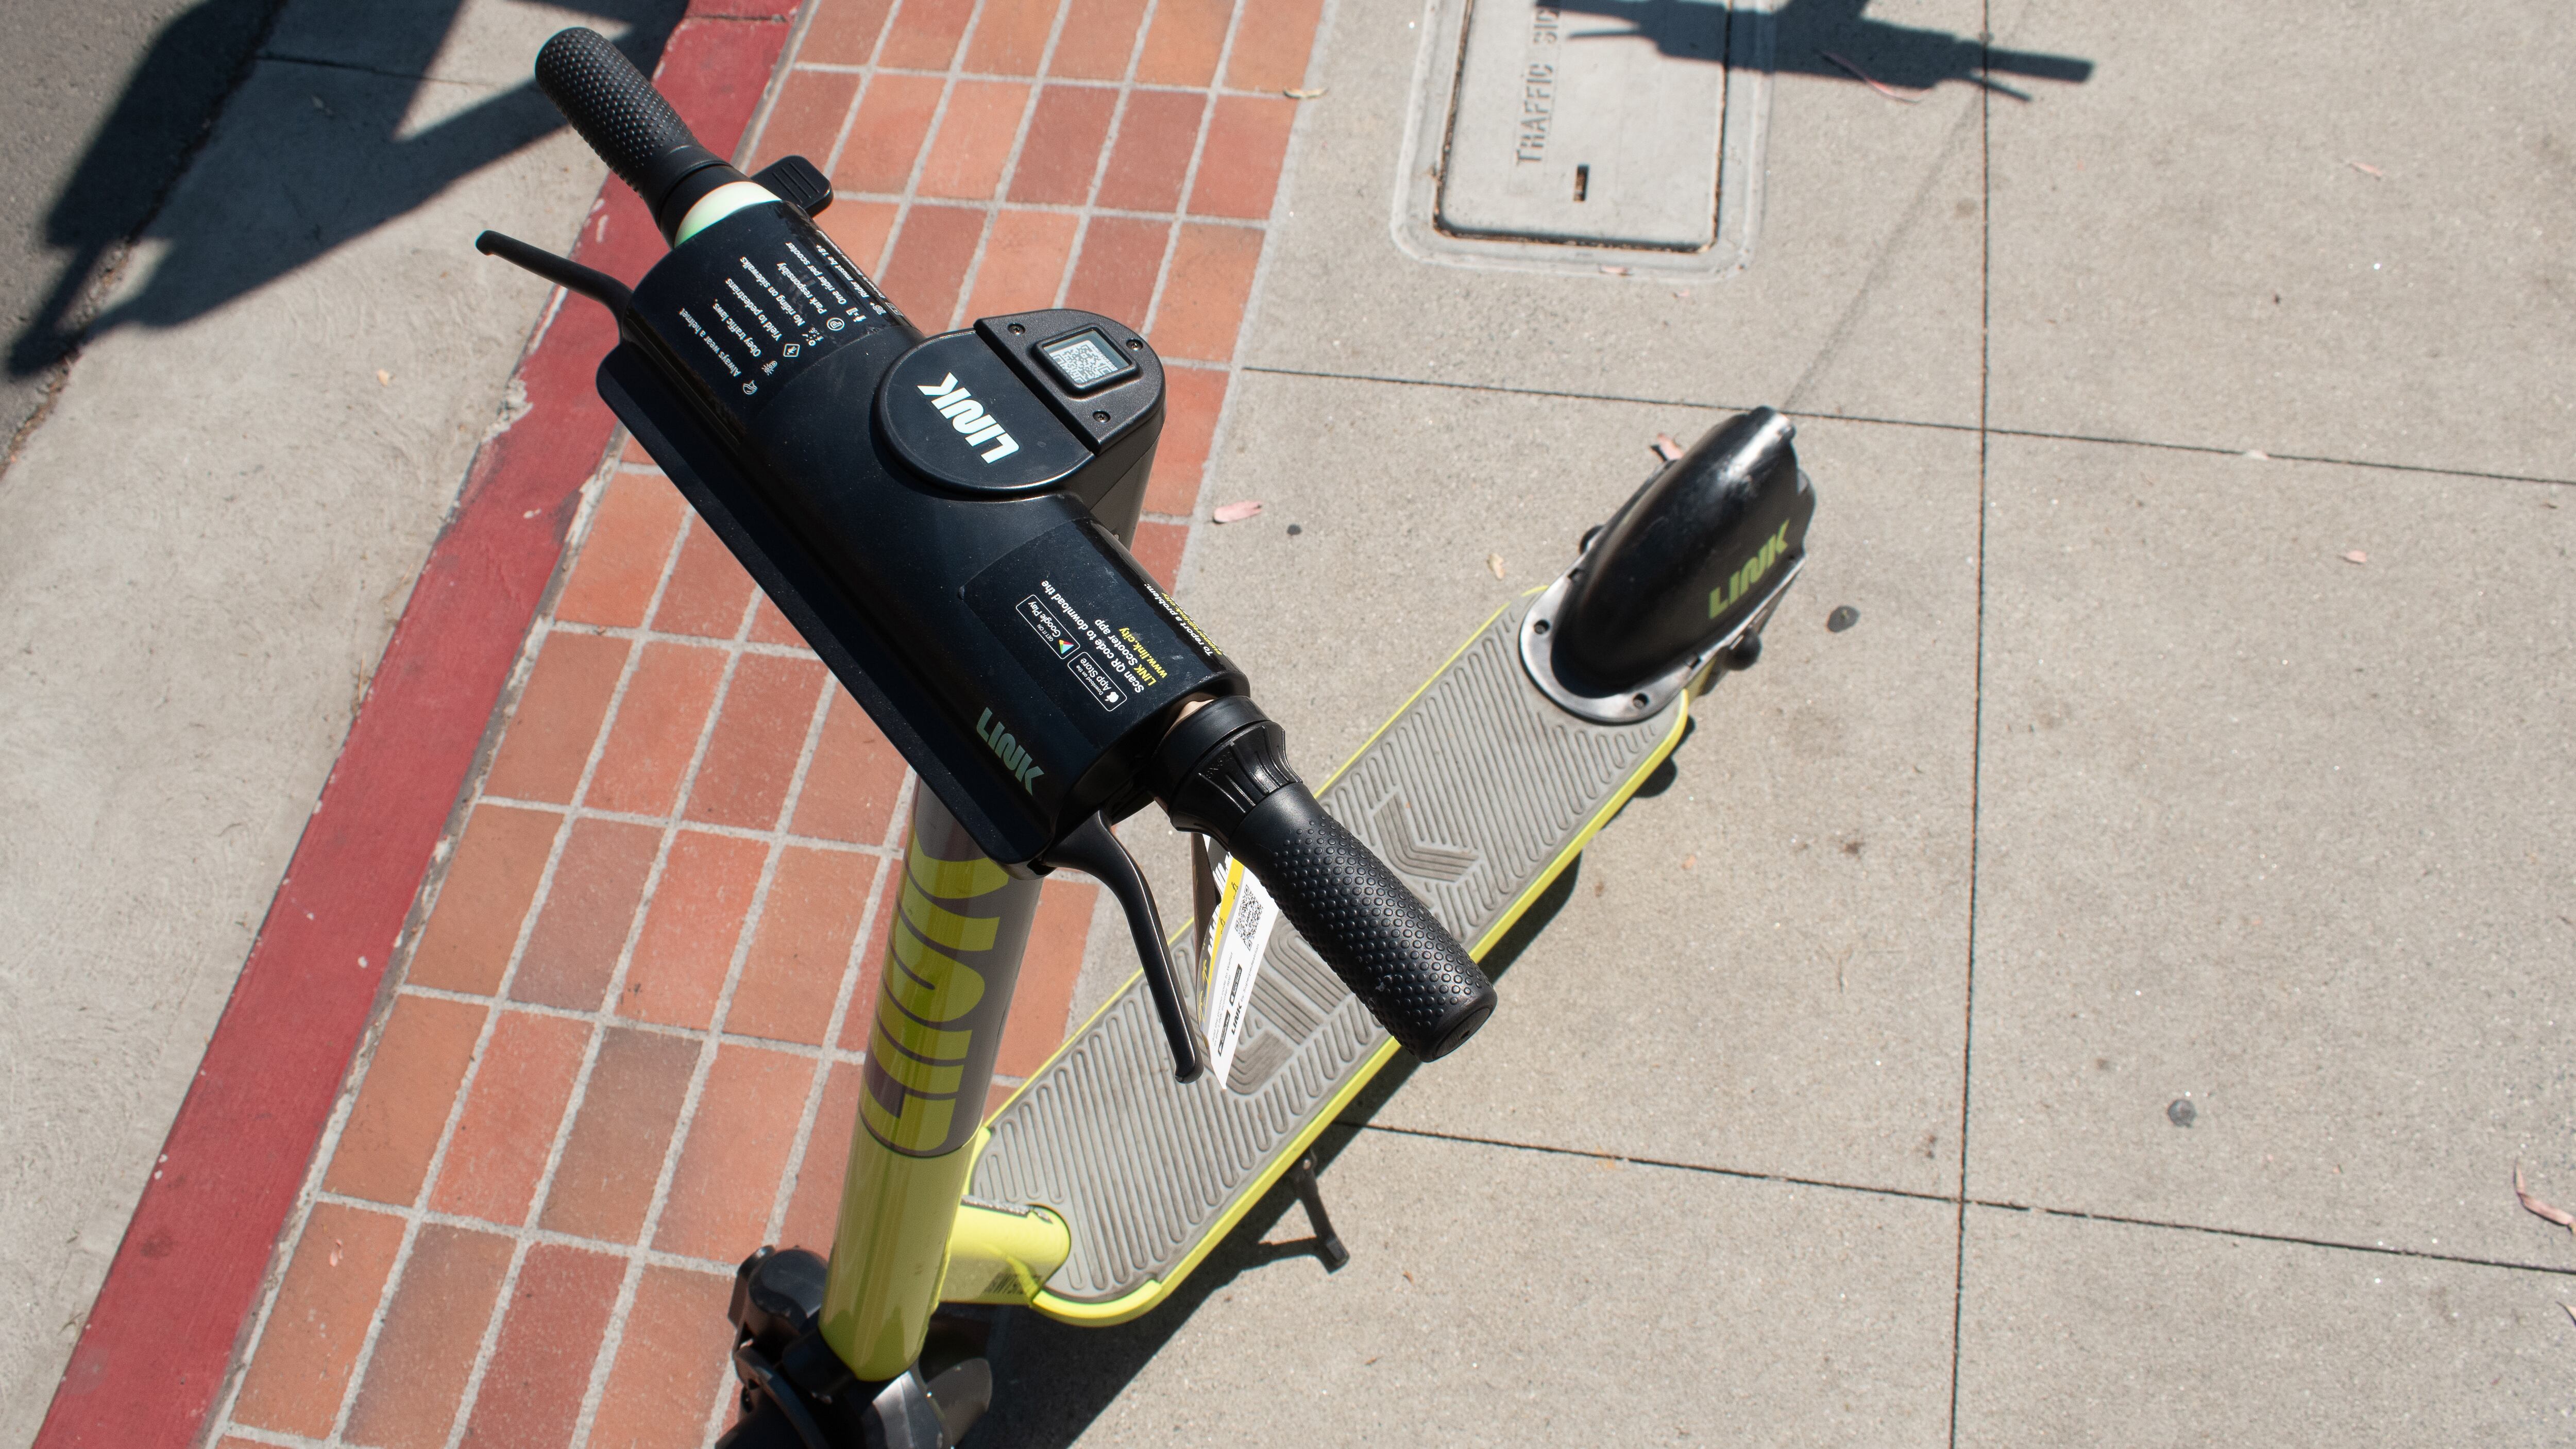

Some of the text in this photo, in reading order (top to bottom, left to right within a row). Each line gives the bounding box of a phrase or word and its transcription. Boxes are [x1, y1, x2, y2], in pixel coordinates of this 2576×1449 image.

[1516, 63, 1553, 166] TRAFFIC
[816, 245, 829, 257] 18+
[827, 257, 838, 265] be
[776, 262, 827, 314] Park responsibly
[785, 242, 847, 305] One rider per scooter
[834, 265, 854, 281] must
[740, 256, 806, 326] No riding on sidewalks
[851, 281, 870, 298] Rider
[679, 308, 702, 334] helmet
[725, 278, 782, 341] Yield to pedestrians
[703, 336, 720, 354] wear
[726, 318, 747, 340] traffic
[743, 337, 761, 357] Obey
[718, 351, 741, 377] Always
[917, 372, 1020, 464] LINK
[1708, 519, 1790, 620] LINK
[1144, 583, 1179, 615] problem:
[1028, 601, 1061, 637] Google Play
[1180, 622, 1205, 645] report
[1041, 580, 1144, 693] Scan QR code to download the
[1045, 633, 1054, 642] GET
[1094, 619, 1157, 686] LINK Scooter app
[1203, 647, 1213, 655] To
[1118, 628, 1167, 678] www.link.city
[1080, 658, 1112, 691] App Store
[1086, 676, 1104, 696] Download
[976, 707, 1044, 796] LINK
[1231, 1002, 1242, 1035] LINK
